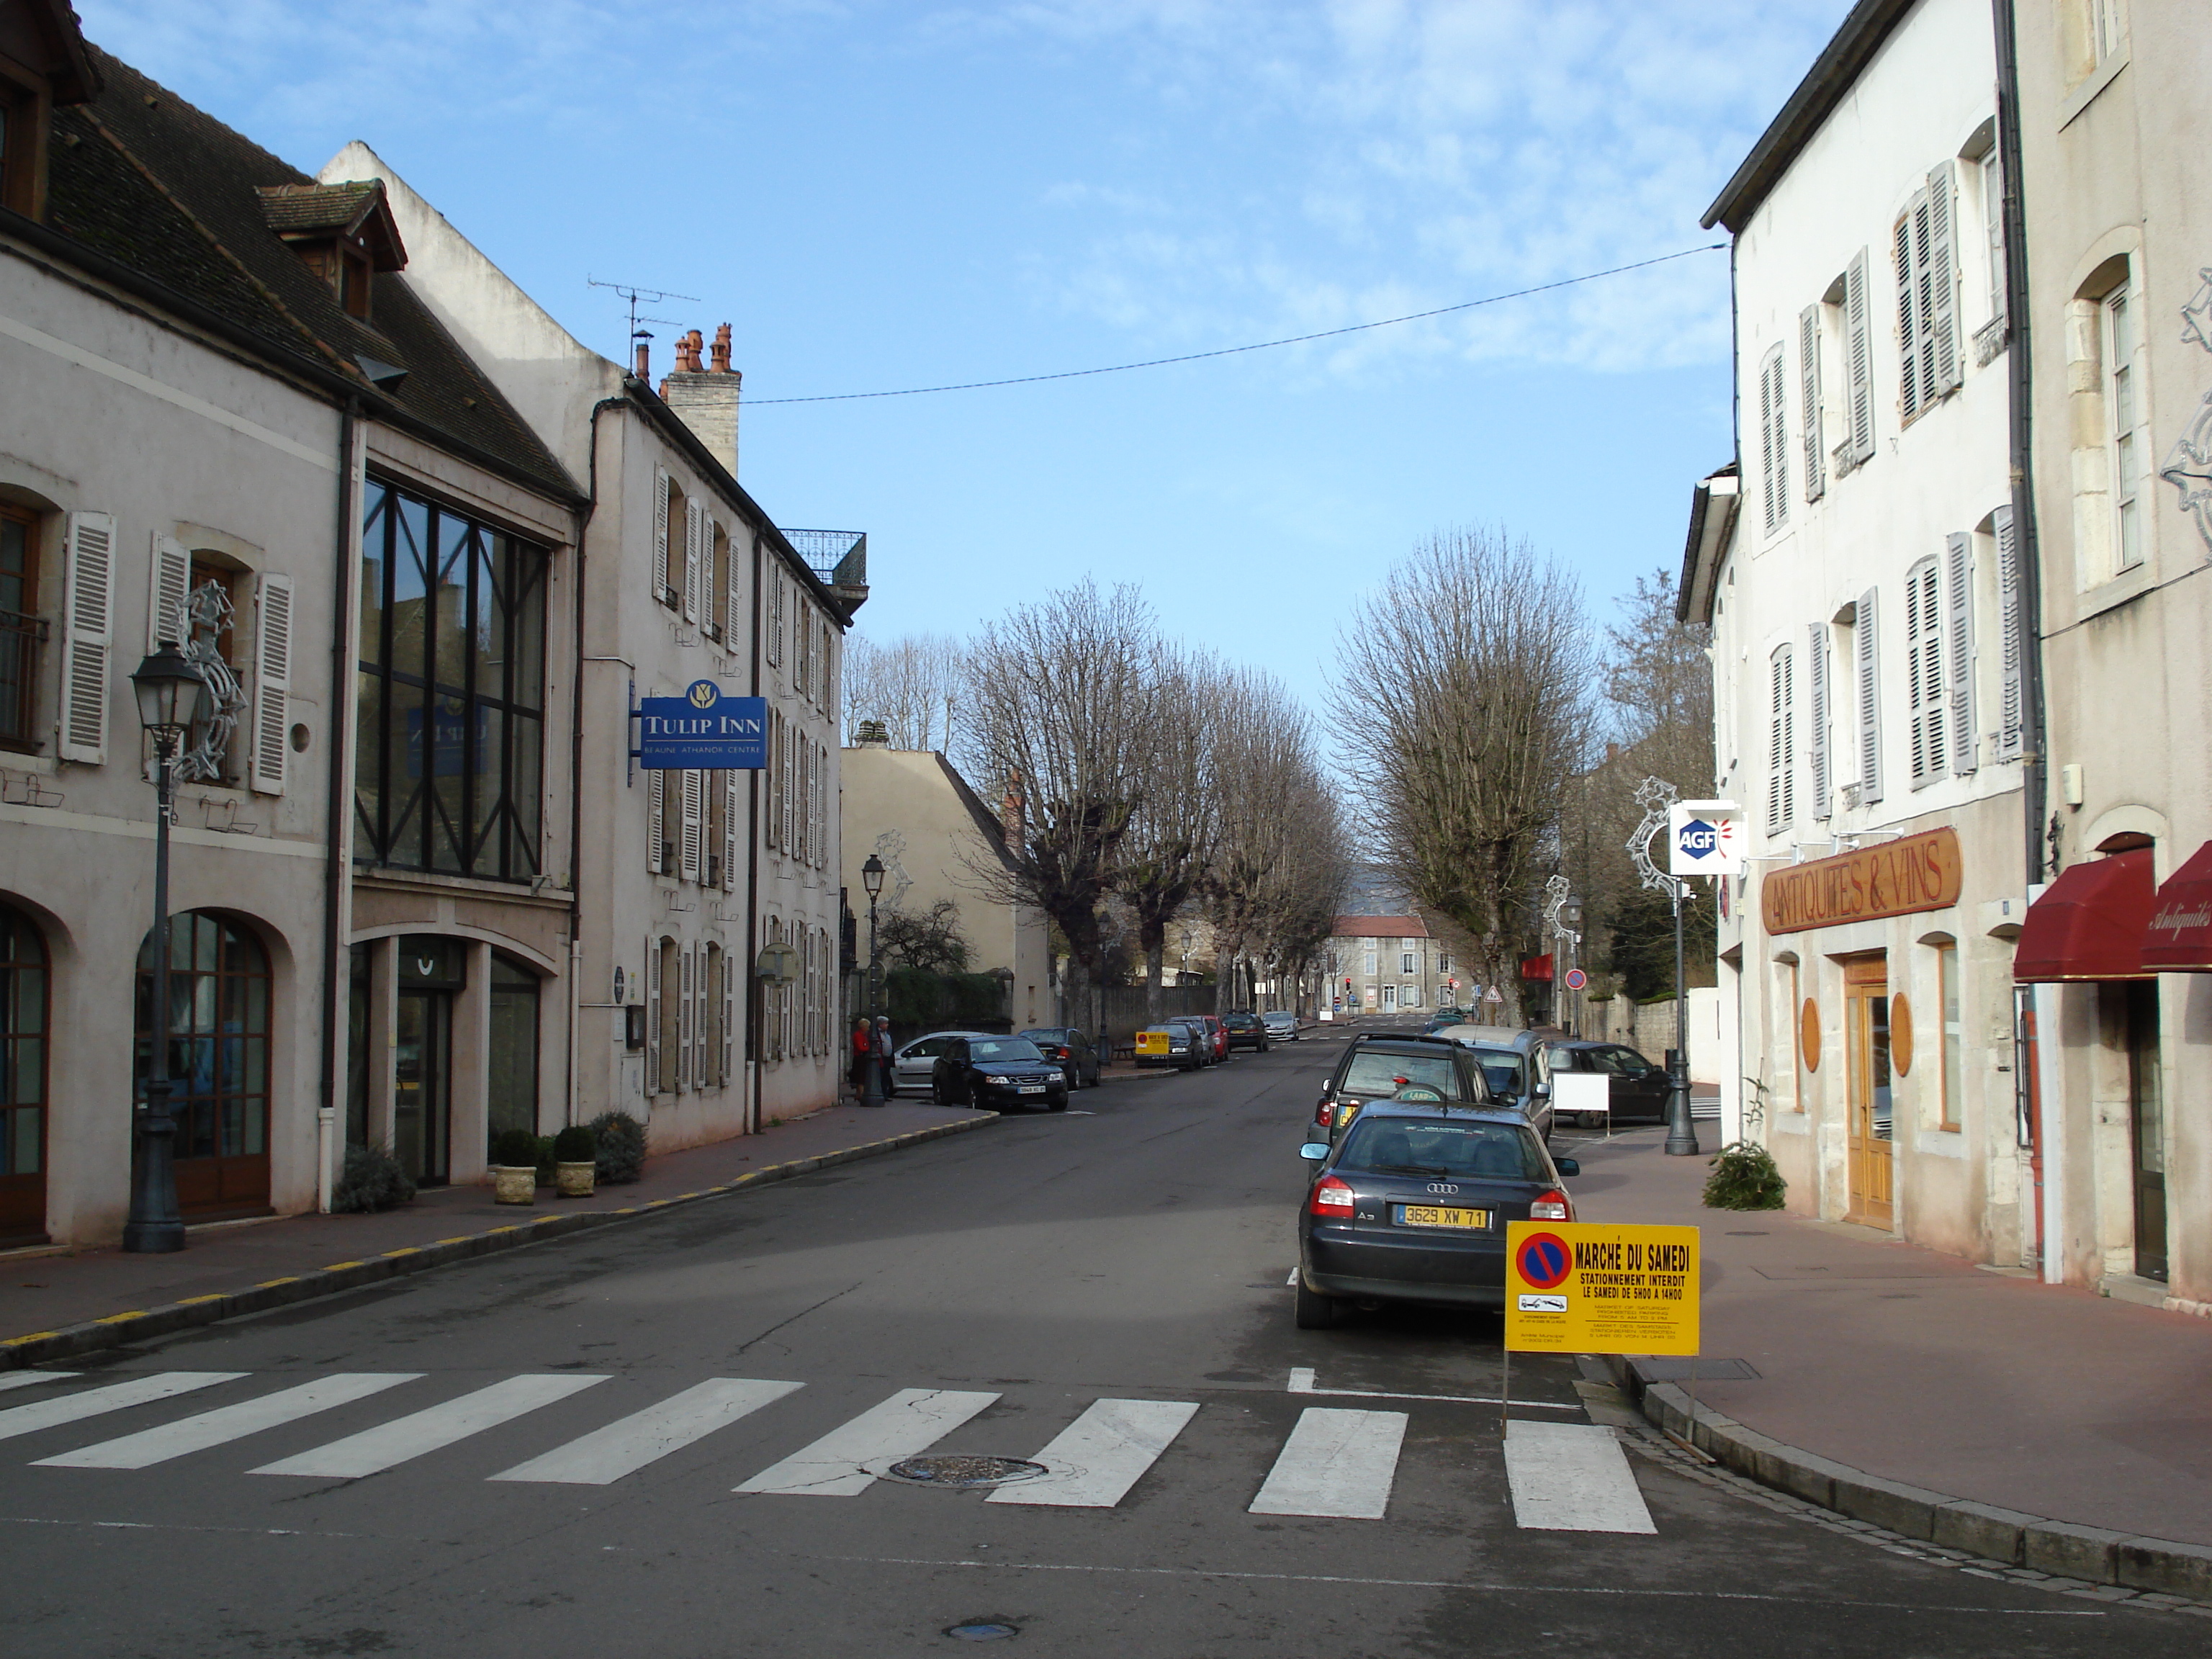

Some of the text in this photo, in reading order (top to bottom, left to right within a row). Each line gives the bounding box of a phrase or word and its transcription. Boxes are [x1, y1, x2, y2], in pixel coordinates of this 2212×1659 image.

[645, 716, 760, 734] TULIP INN
[1679, 831, 1716, 850] AGF
[1870, 854, 1887, 912] &
[1889, 839, 1942, 907] VINS
[1357, 1212, 1375, 1220] A3
[1406, 1208, 1482, 1226] 3629 XW 71
[1575, 1235, 1689, 1272] MARCHÉ DU SAMEDI
[1580, 1273, 1685, 1287] STATIONNEMENT INTERDIT
[1583, 1286, 1682, 1300] LE SAMEDI DE 5H00 A 14H00
